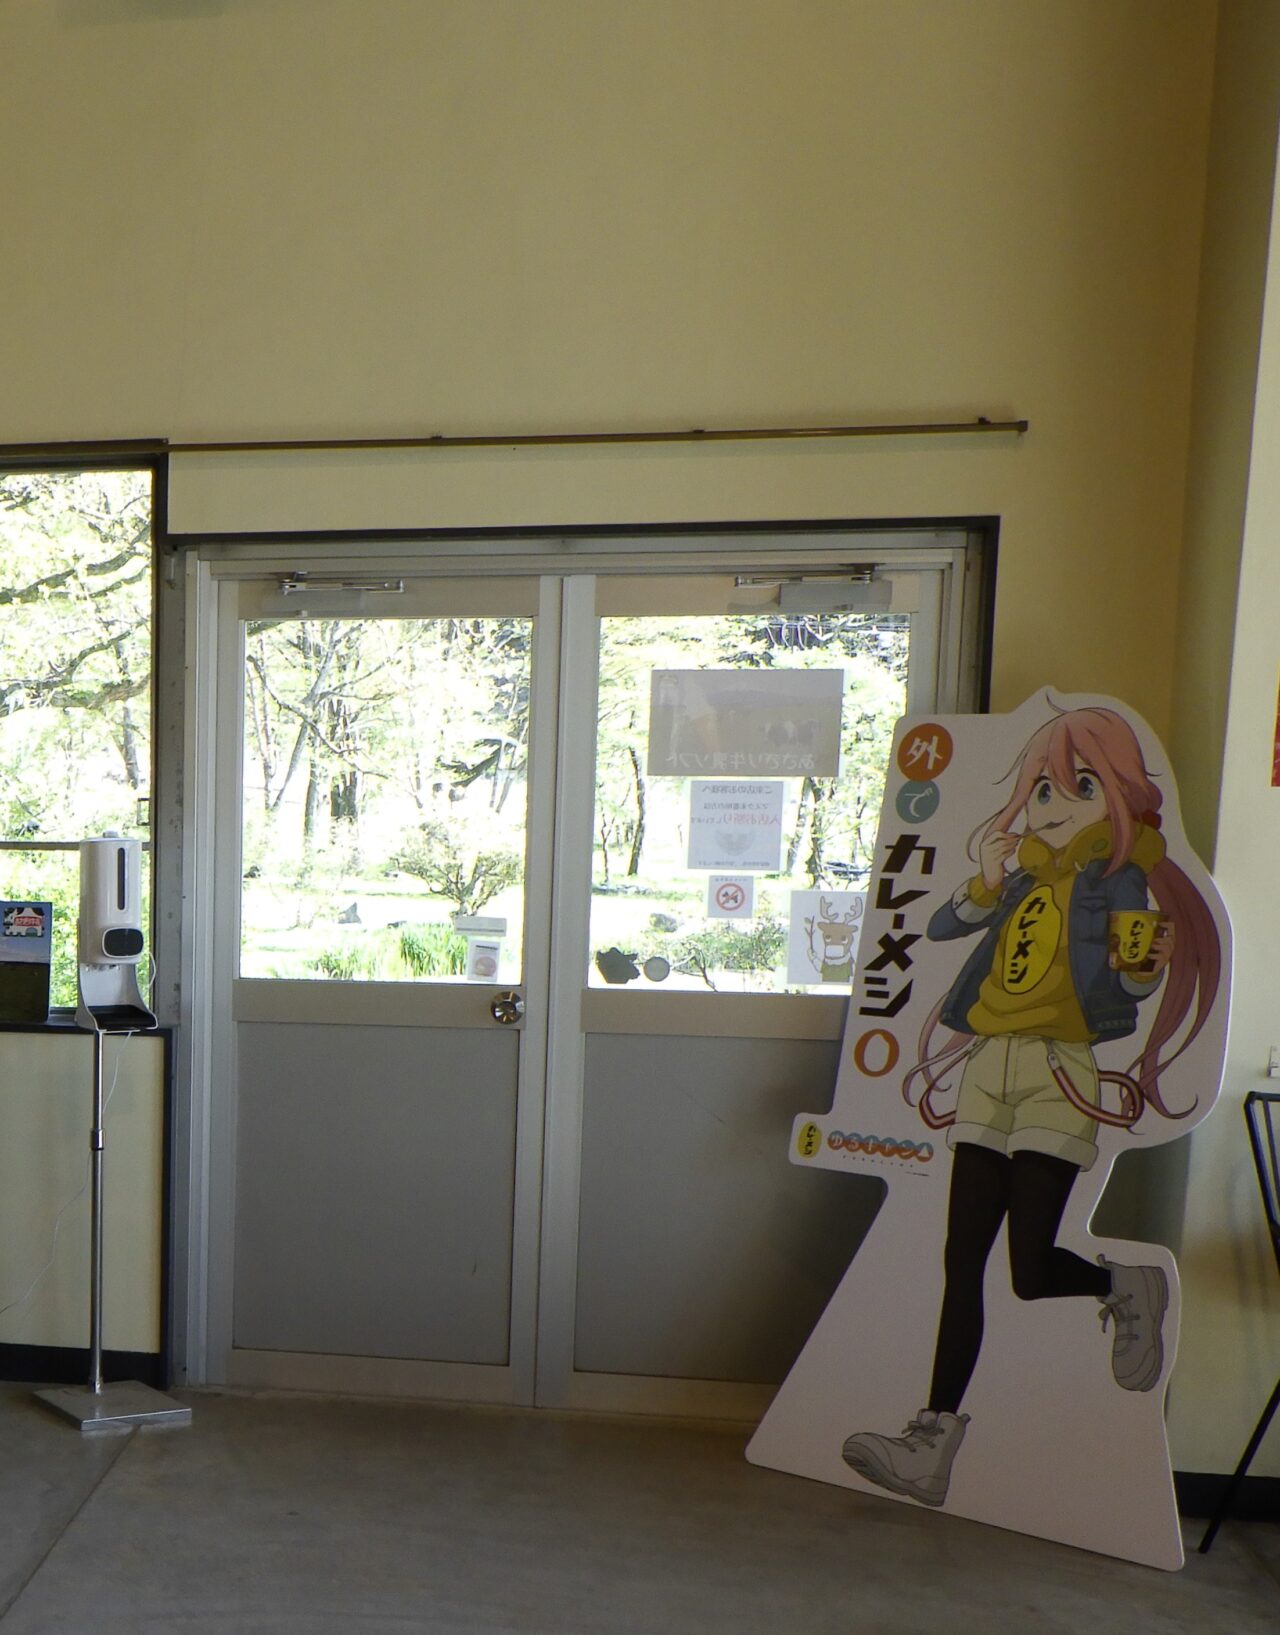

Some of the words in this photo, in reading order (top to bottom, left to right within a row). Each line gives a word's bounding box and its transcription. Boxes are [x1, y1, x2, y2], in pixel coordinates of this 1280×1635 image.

[1006, 895, 1048, 985] カレーメシ
